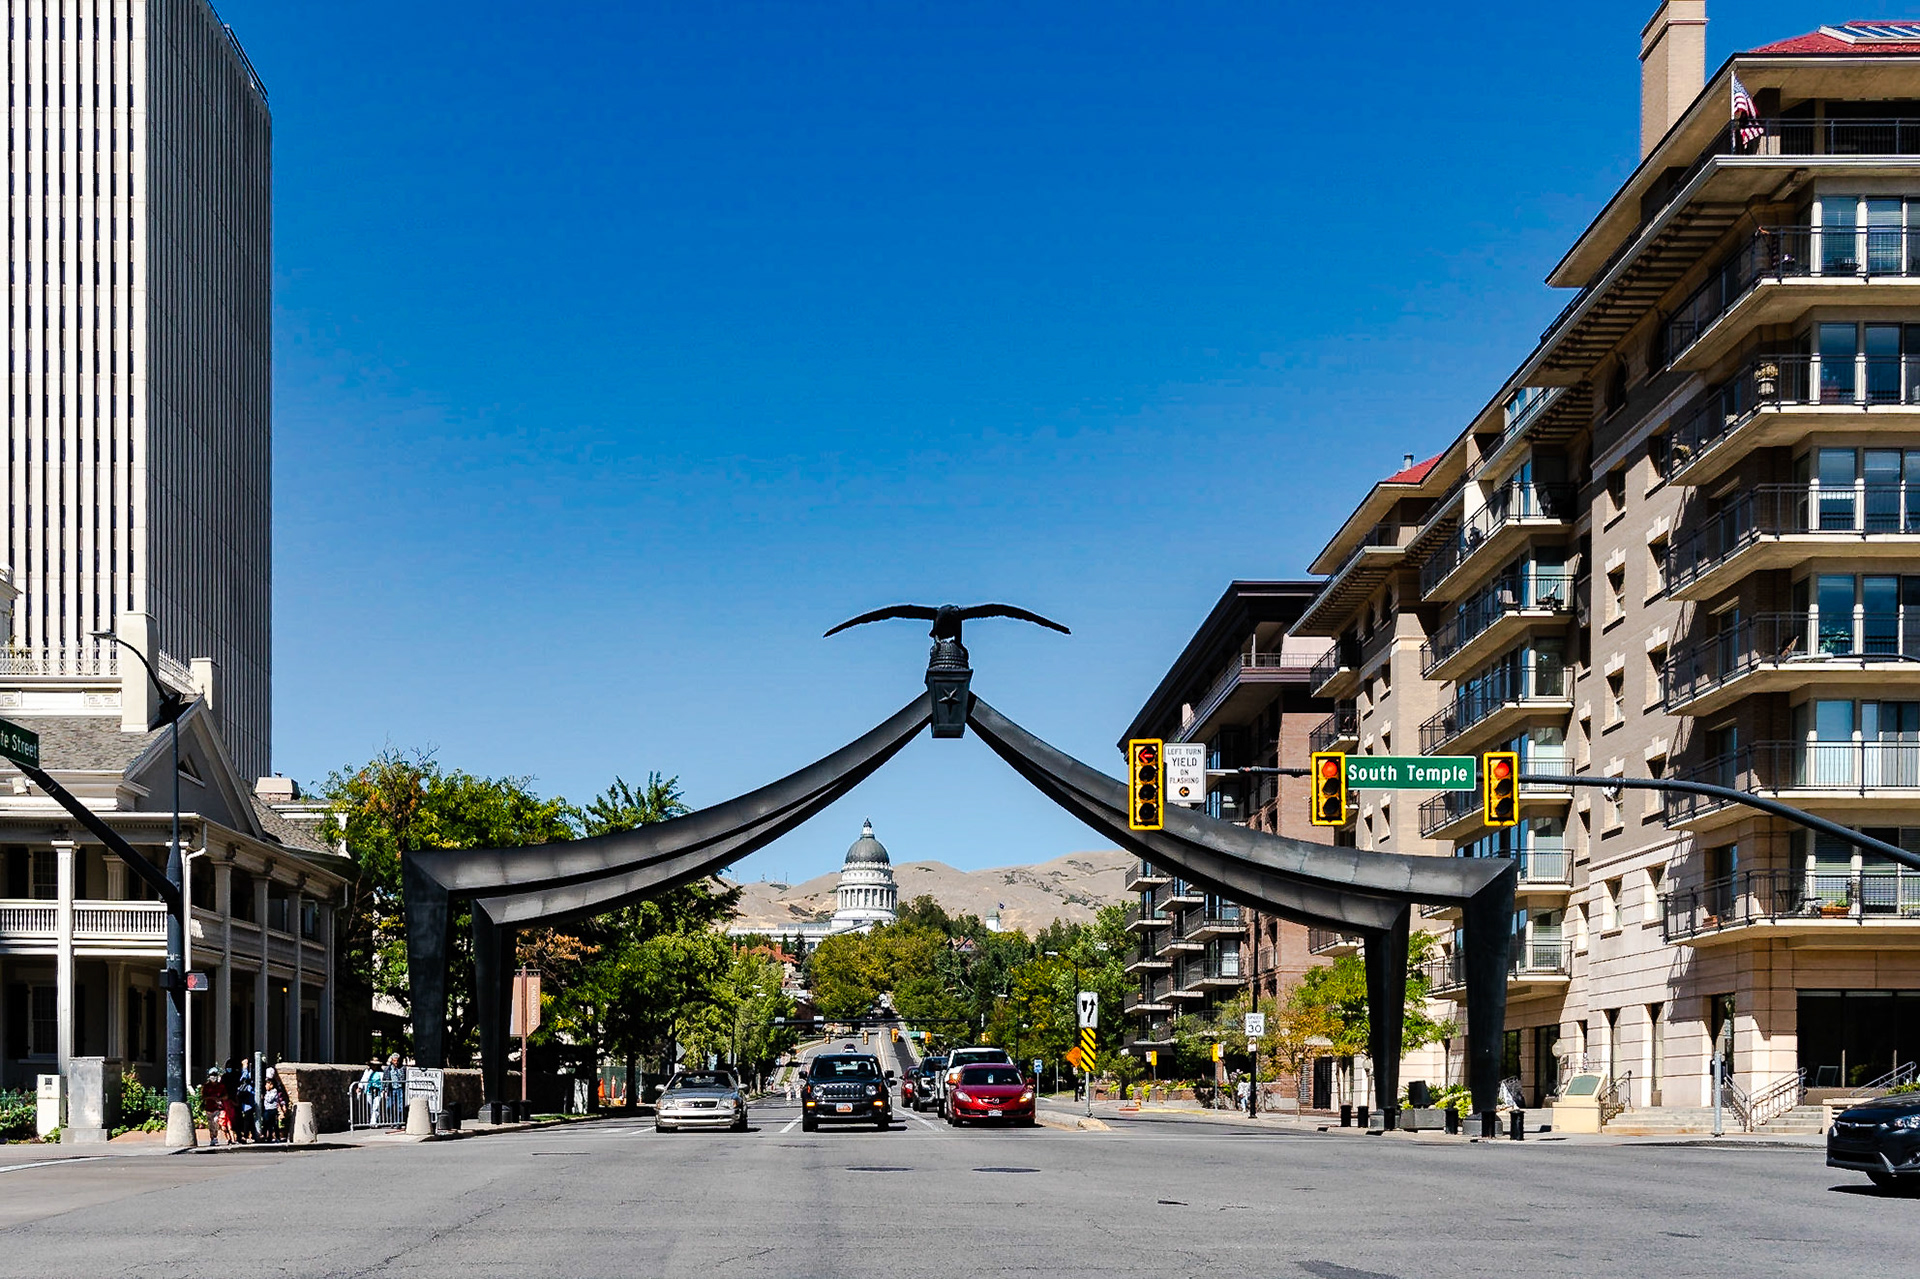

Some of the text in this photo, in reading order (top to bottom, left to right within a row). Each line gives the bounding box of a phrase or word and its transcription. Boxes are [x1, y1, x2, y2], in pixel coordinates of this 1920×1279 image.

[12, 733, 38, 759] Street
[1185, 748, 1202, 756] TURN
[1172, 757, 1197, 767] YIELD
[1348, 764, 1468, 785] South Temple
[1248, 1024, 1262, 1033] 30
[411, 1071, 438, 1079] SIDEWALK
